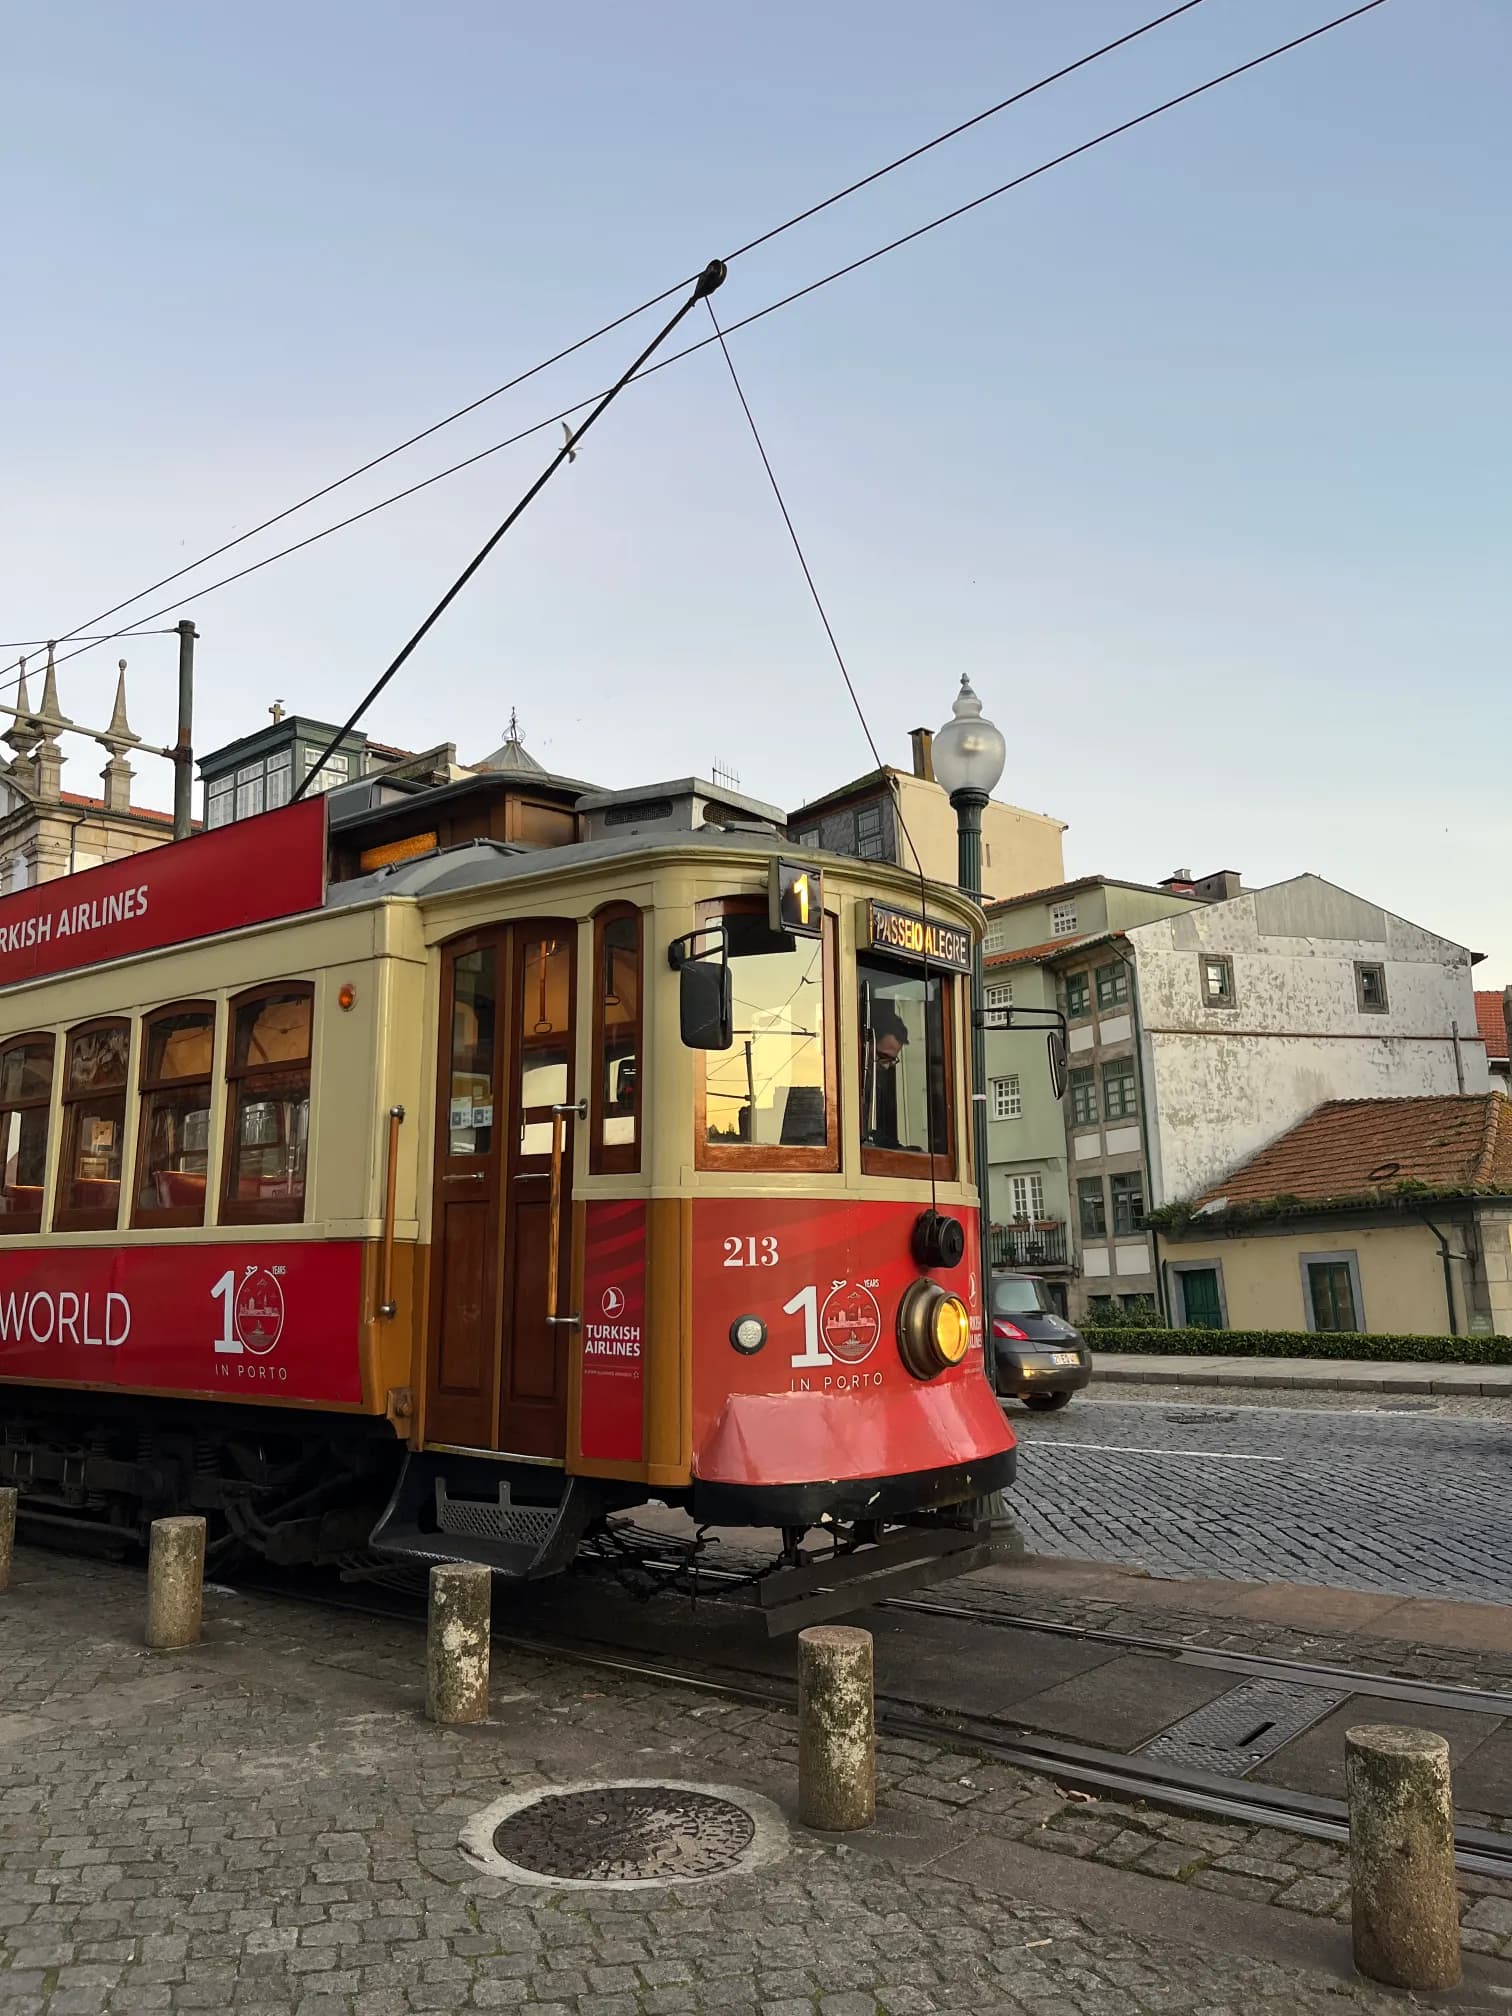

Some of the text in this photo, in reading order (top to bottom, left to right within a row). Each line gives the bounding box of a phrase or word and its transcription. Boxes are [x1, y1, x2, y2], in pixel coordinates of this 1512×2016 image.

[793, 873, 809, 925] 1
[56, 884, 149, 939] AIRLINES
[875, 911, 967, 964] PASSEIO ALEGRE
[723, 1236, 779, 1267] 213
[272, 1265, 287, 1275] YEARS
[863, 1279, 880, 1289] YEARS
[0, 1291, 131, 1346] WORLD
[585, 1324, 640, 1340] TURKISH
[585, 1340, 641, 1357] AIRLINES
[215, 1363, 287, 1380] IN PORTO
[791, 1372, 883, 1392] IN PORTO
